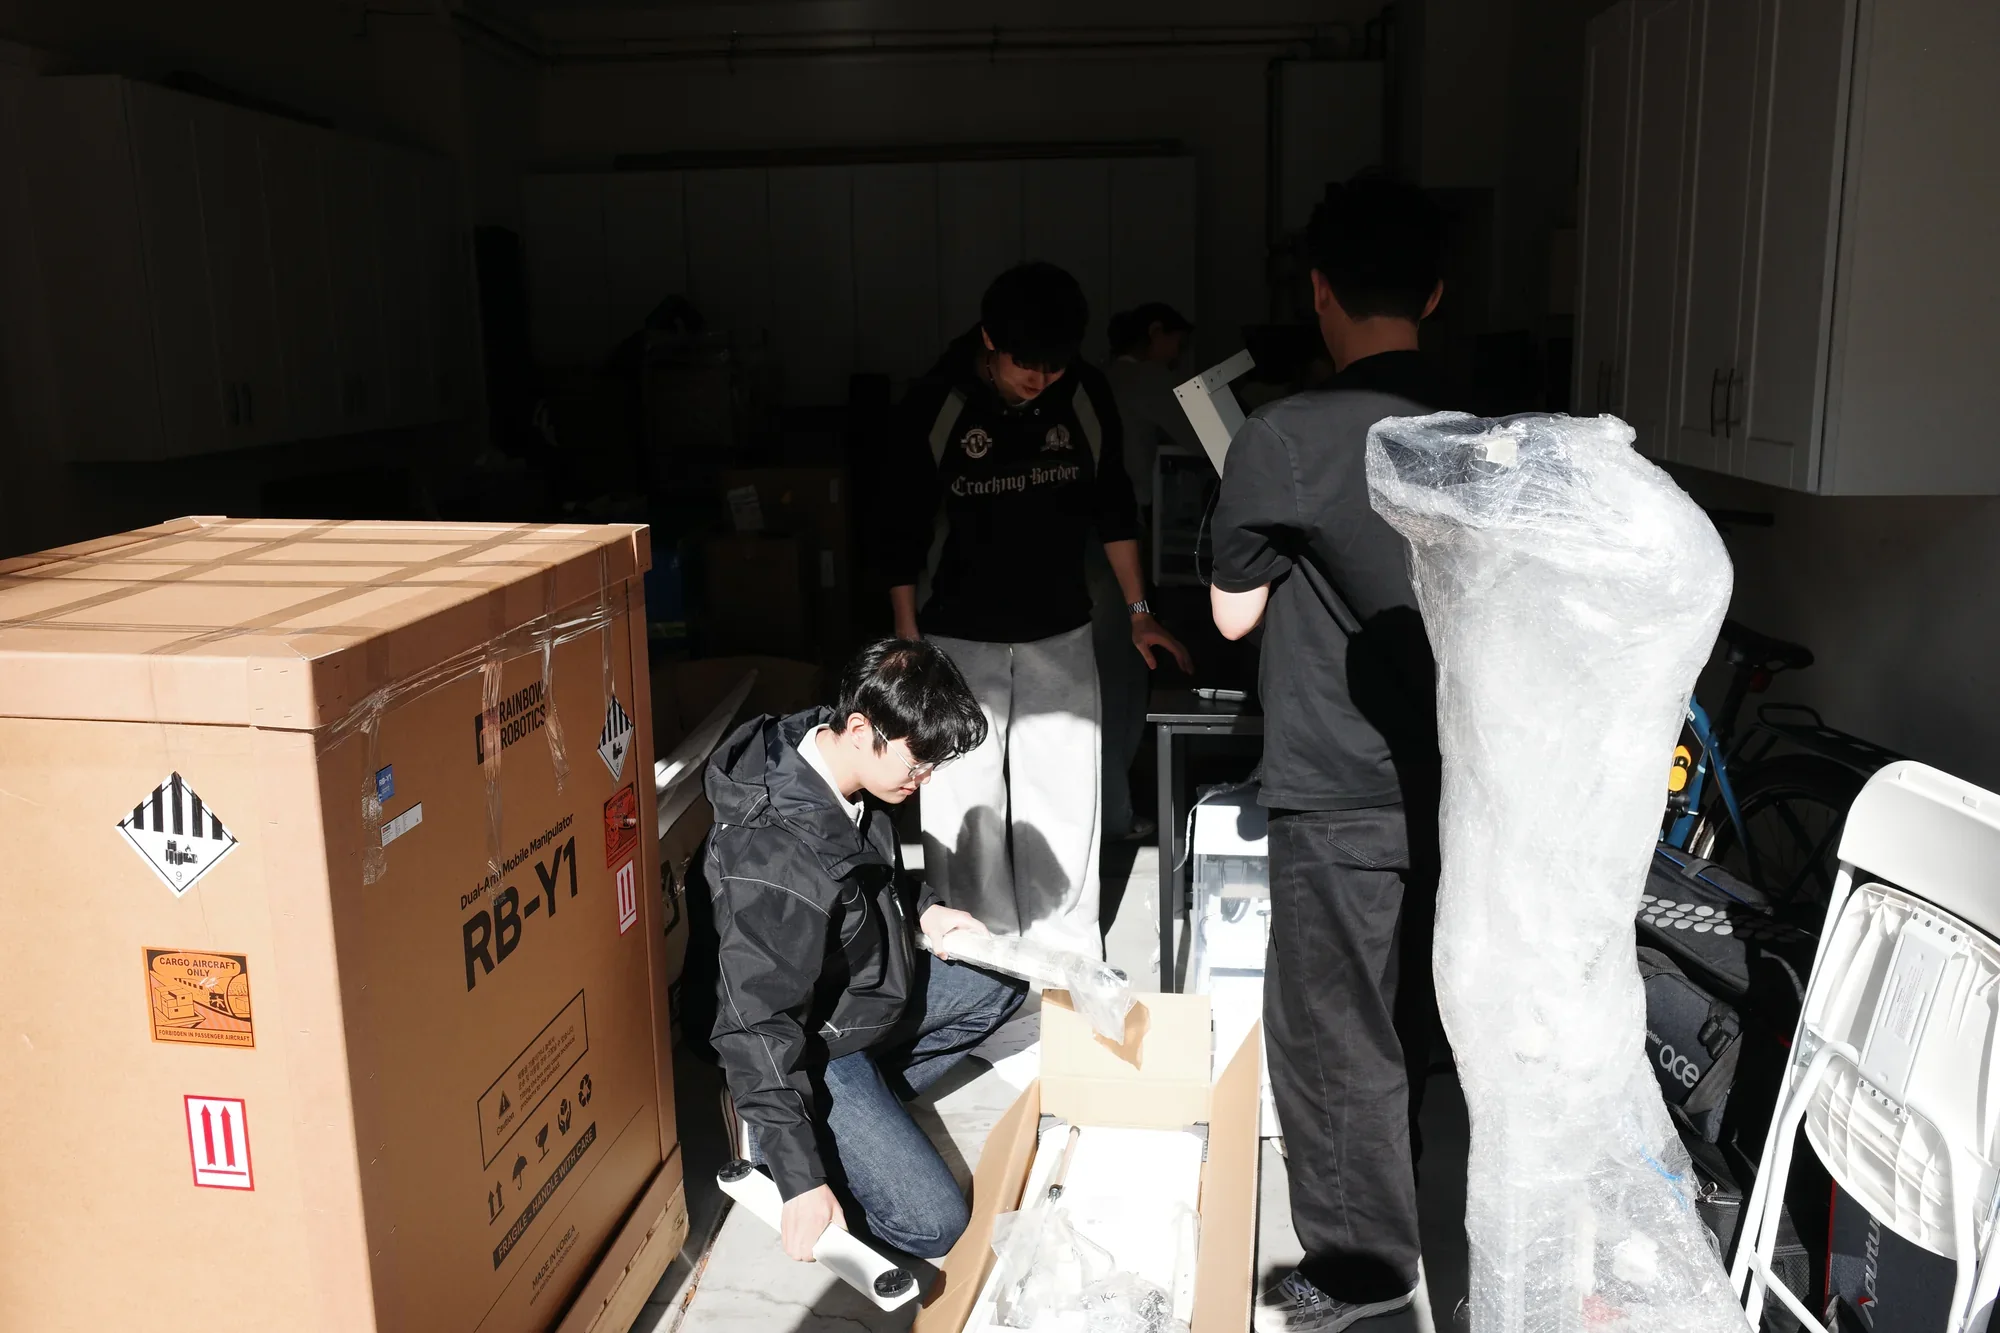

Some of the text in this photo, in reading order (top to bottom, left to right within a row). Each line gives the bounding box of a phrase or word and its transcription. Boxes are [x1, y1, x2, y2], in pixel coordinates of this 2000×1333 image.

[951, 464, 1080, 496] Cracking Border
[500, 680, 544, 724] RAINBOW
[500, 704, 546, 750] ROBOTICS
[176, 870, 182, 880] 9
[460, 870, 502, 910] Dual-Arm
[502, 847, 529, 877] Mobile
[530, 813, 574, 855] Manipulator
[462, 836, 578, 992] RB-Y1
[160, 957, 236, 970] CARGO AIRCRAFT
[186, 968, 210, 977] ONLY
[1659, 1044, 1700, 1088] ace
[496, 1112, 515, 1136] Caution
[498, 1213, 528, 1258] FRAGILE
[532, 1173, 558, 1214] HANDLE
[558, 1153, 576, 1180] WITH
[576, 1128, 593, 1158] CARE
[532, 1224, 576, 1290] MADE IN KOREA
